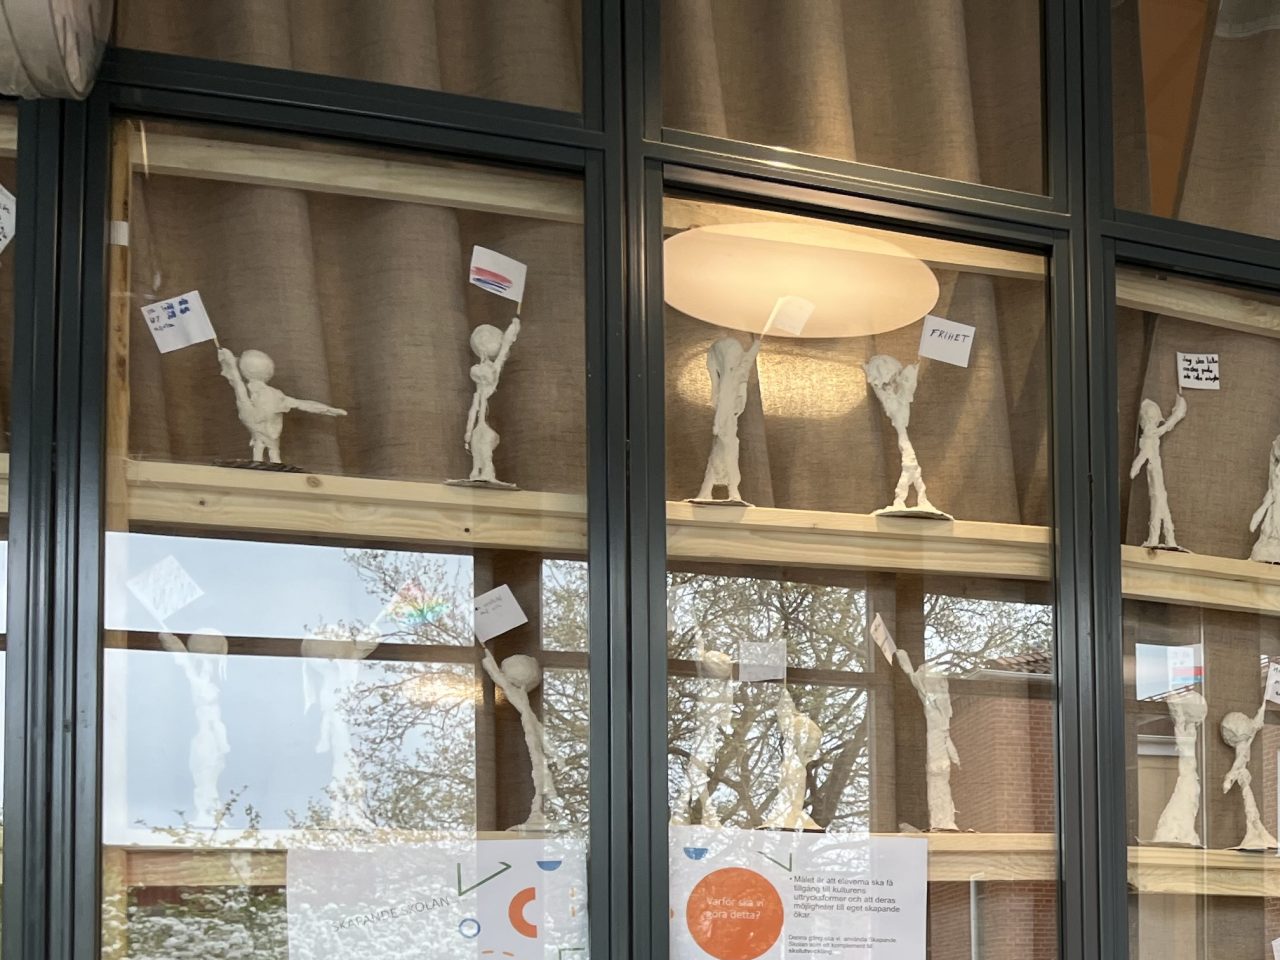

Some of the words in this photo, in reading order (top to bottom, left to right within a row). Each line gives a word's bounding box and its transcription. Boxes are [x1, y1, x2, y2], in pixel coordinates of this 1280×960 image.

[930, 328, 970, 342] FRIHET
[794, 884, 820, 893] tillgång
[794, 904, 834, 912] möjligheter
[864, 905, 900, 913] skapande
[332, 908, 399, 932] SKAPANDE
[400, 897, 450, 917] SKOLAN
[730, 910, 760, 920] detta?
